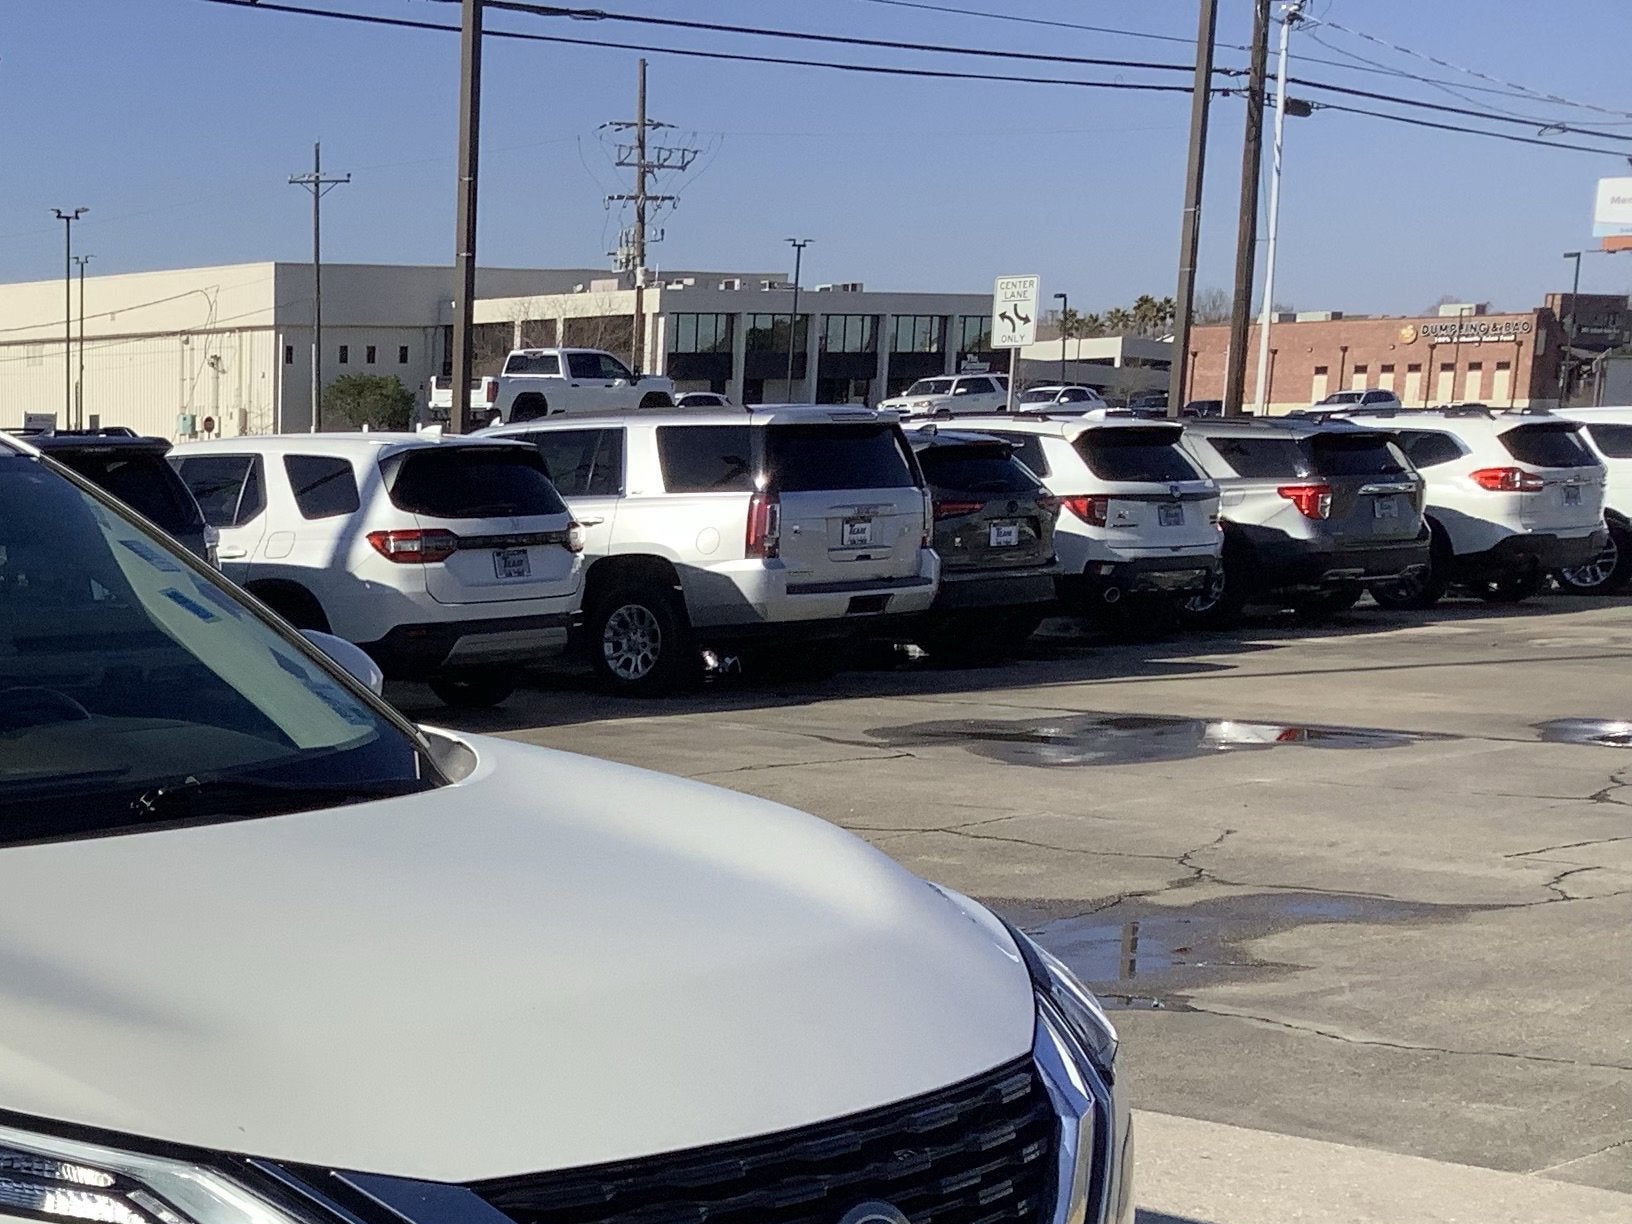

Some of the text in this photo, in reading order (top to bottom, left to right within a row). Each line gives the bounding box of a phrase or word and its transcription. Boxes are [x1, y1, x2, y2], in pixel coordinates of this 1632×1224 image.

[1000, 280, 1035, 290] CENTER
[1004, 290, 1028, 299] LANE
[1491, 322, 1503, 333] &
[1504, 321, 1531, 333] BAO
[1000, 334, 1026, 343] ONLY
